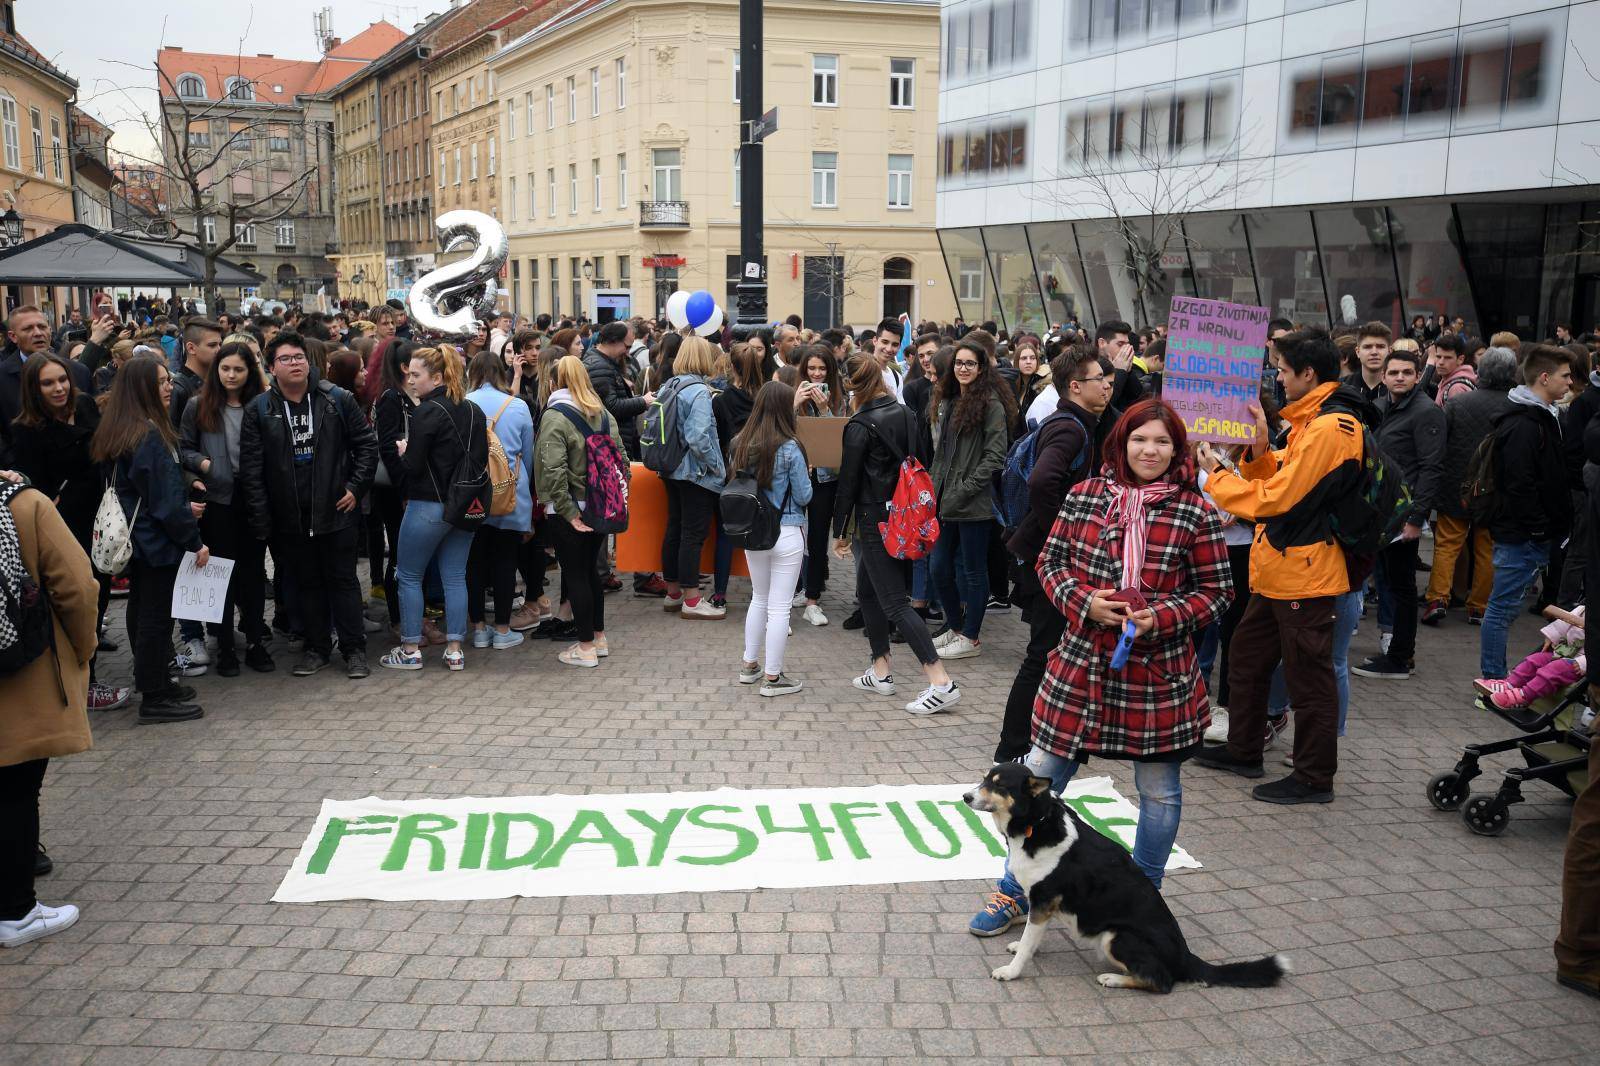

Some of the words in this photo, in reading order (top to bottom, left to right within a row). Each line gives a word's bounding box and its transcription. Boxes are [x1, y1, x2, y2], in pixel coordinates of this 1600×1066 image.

[1170, 317, 1189, 330] ZA
[1171, 300, 1213, 316] UZGOJ
[1217, 303, 1269, 324] ŽIVOTINJA
[1165, 353, 1261, 380] GLOBALNOG
[1166, 376, 1257, 402] ZATOPLJENJA
[180, 585, 202, 606] PLAN
[208, 587, 216, 607] B
[306, 793, 1178, 875] FRIDAYS4FUTE
